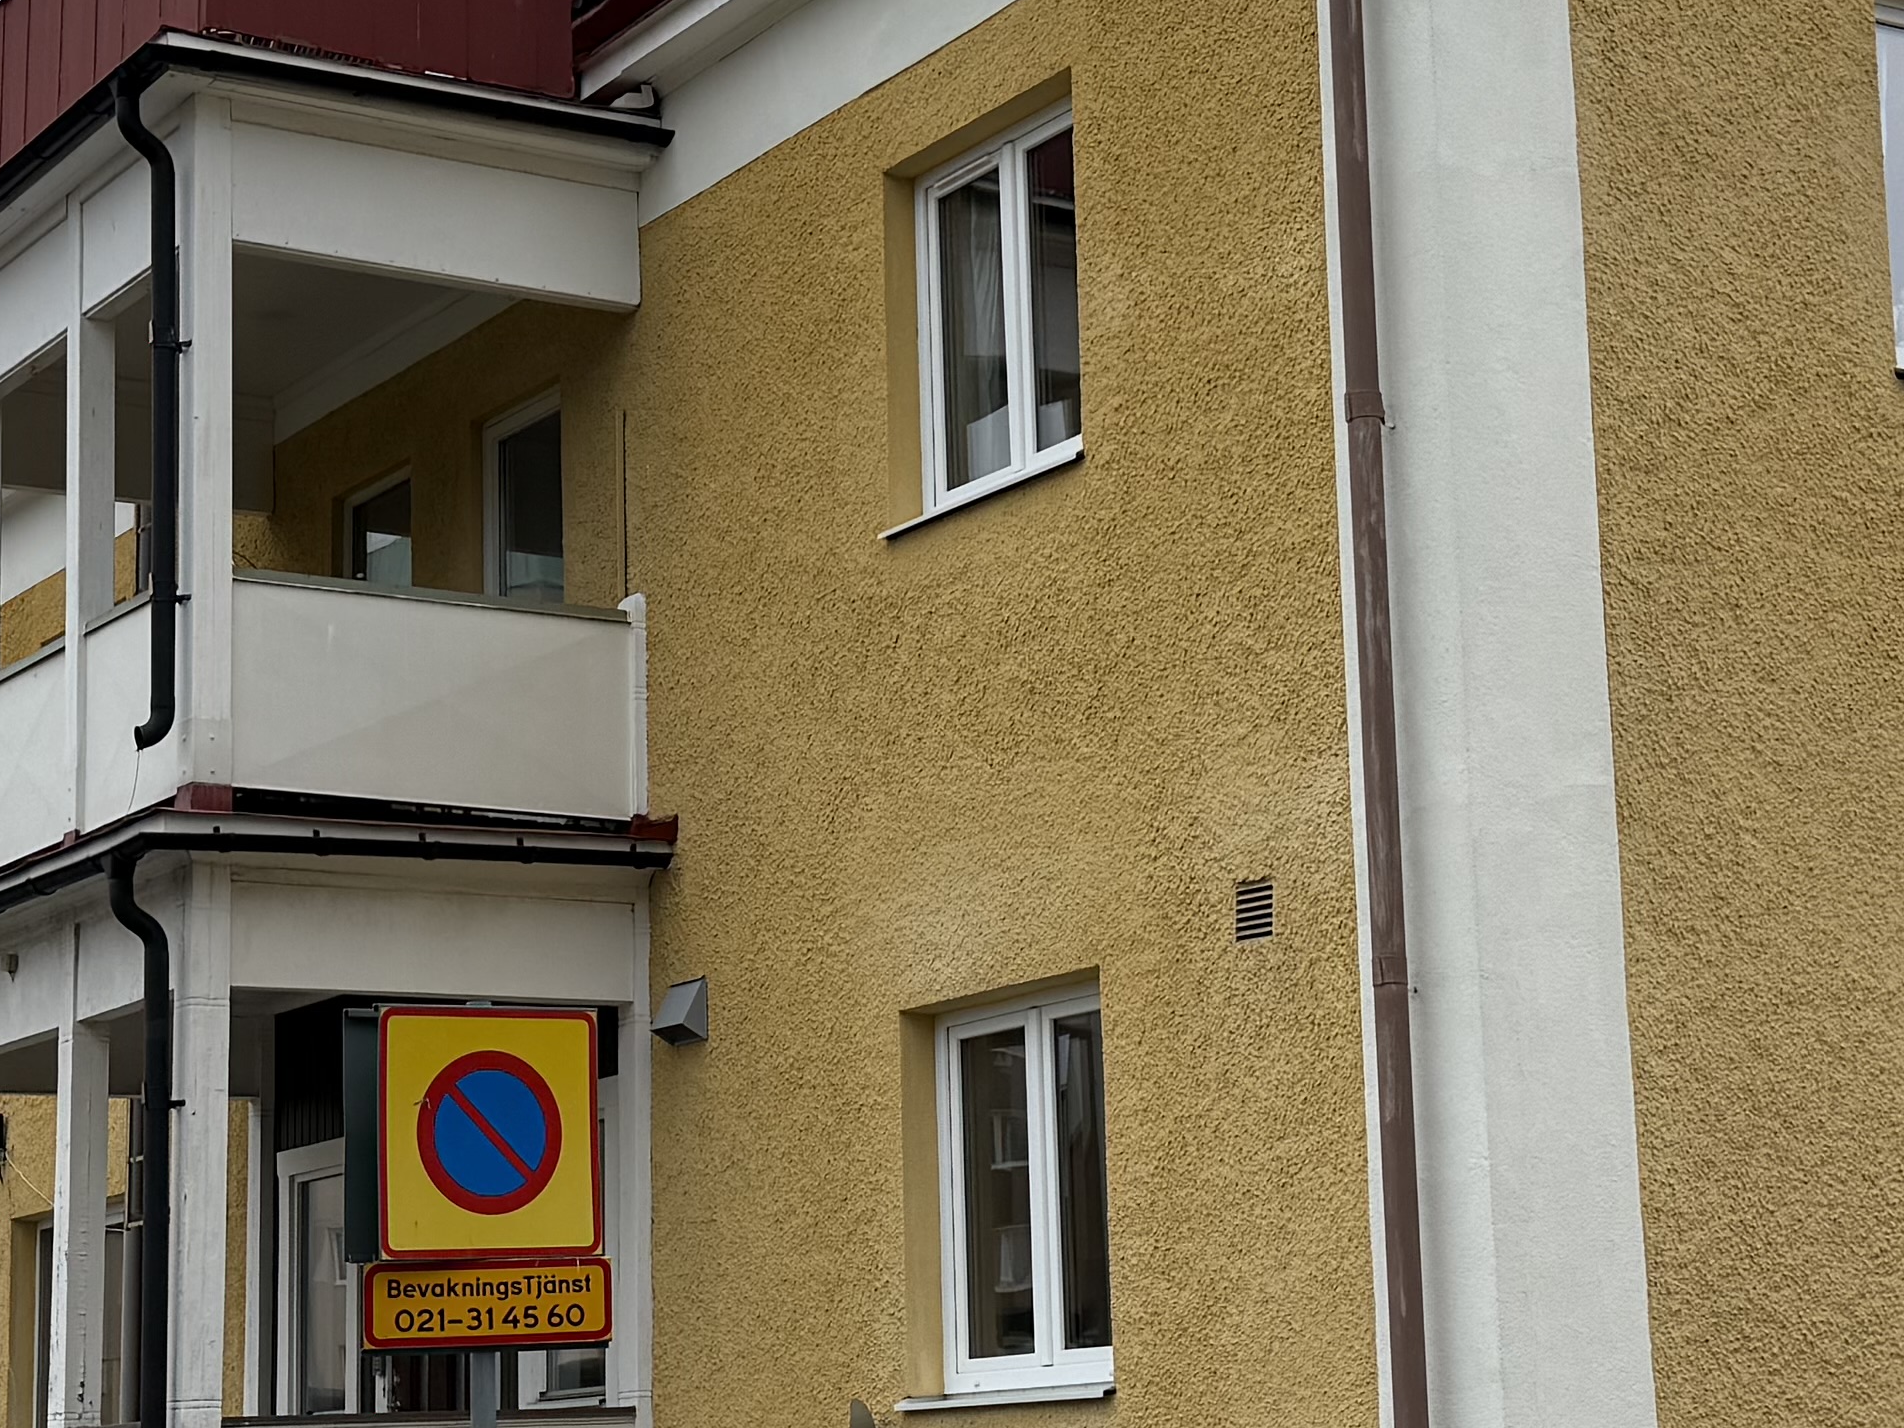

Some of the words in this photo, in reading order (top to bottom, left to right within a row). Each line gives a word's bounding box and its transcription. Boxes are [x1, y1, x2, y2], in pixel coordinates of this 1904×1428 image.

[387, 1274, 592, 1301] BevakningsTjänst
[394, 1307, 494, 1333] 021-31
[501, 1305, 539, 1330] 45
[547, 1303, 585, 1328] 60
